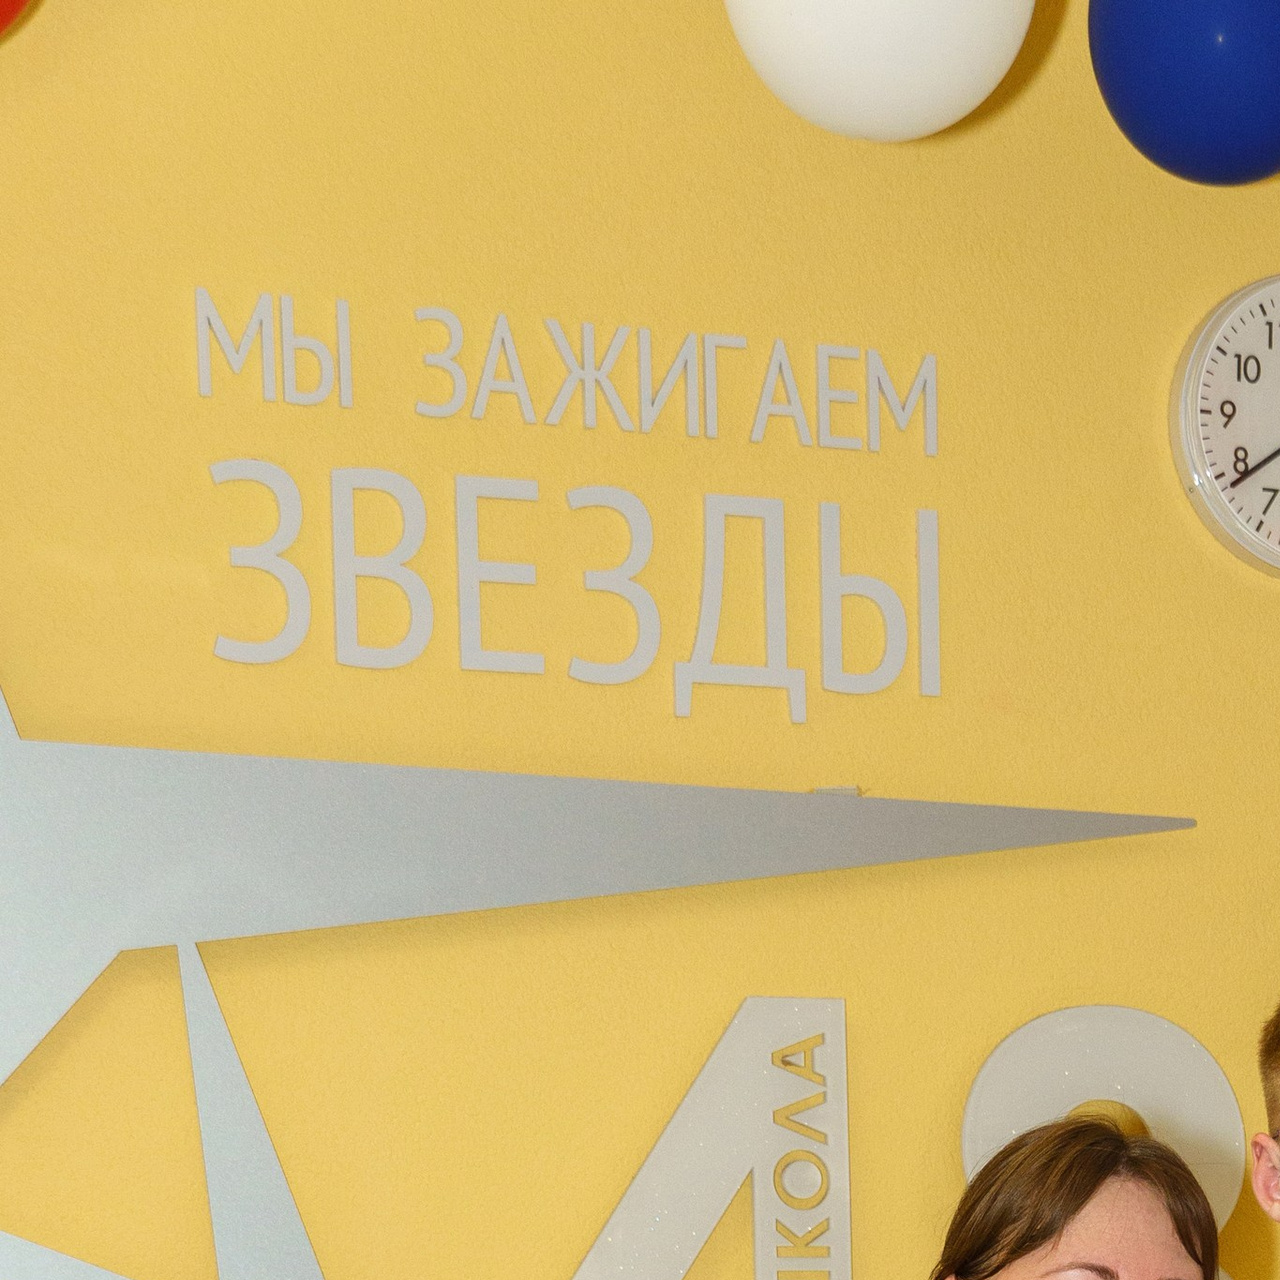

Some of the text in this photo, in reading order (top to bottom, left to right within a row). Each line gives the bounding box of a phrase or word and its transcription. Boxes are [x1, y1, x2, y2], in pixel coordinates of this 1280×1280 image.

[195, 287, 939, 457] МЫ ЗАЖИГАЕМ
[1233, 354, 1261, 384] 10
[1220, 400, 1237, 428] 9
[1233, 446, 1249, 476] 8
[1262, 487, 1280, 515] 7
[208, 458, 942, 724] ЗВЕЗДЫ
